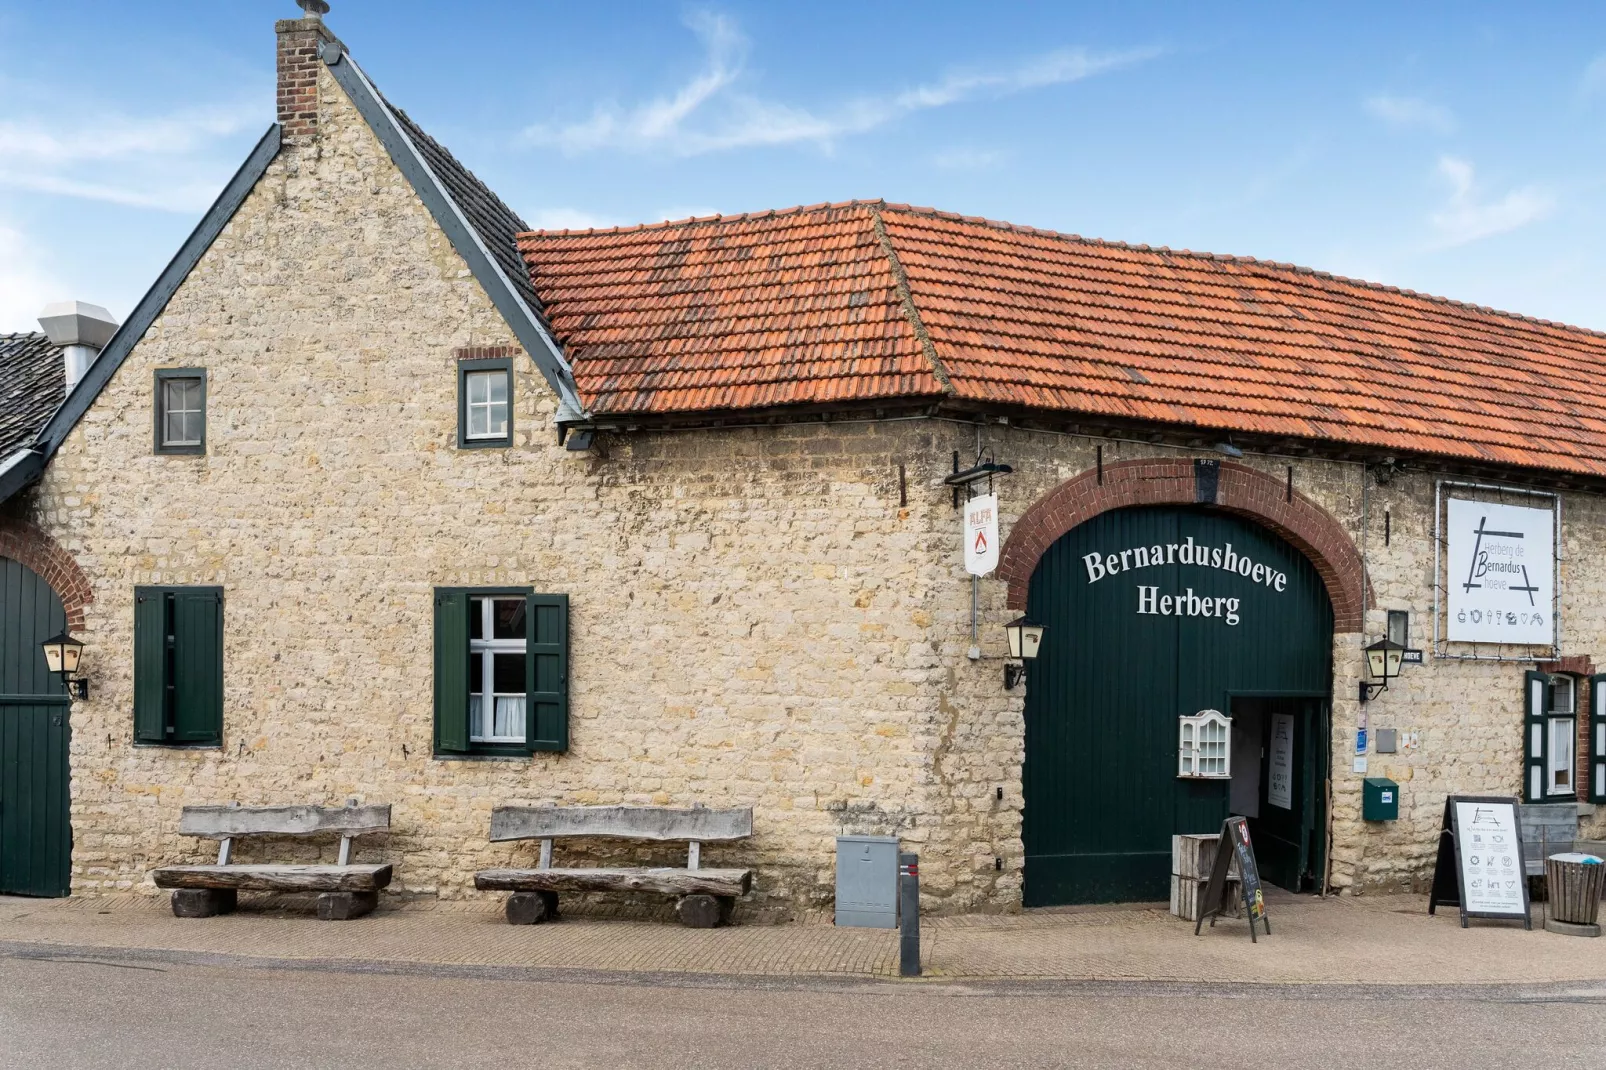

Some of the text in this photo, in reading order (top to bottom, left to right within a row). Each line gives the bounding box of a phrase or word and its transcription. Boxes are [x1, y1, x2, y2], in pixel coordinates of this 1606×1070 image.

[1484, 542, 1524, 559] Herberg de
[1082, 537, 1287, 592] Bernardushoeve
[1475, 551, 1521, 577] Bernardus
[1484, 576, 1507, 590] hoeve
[1136, 585, 1240, 625] Herberg
